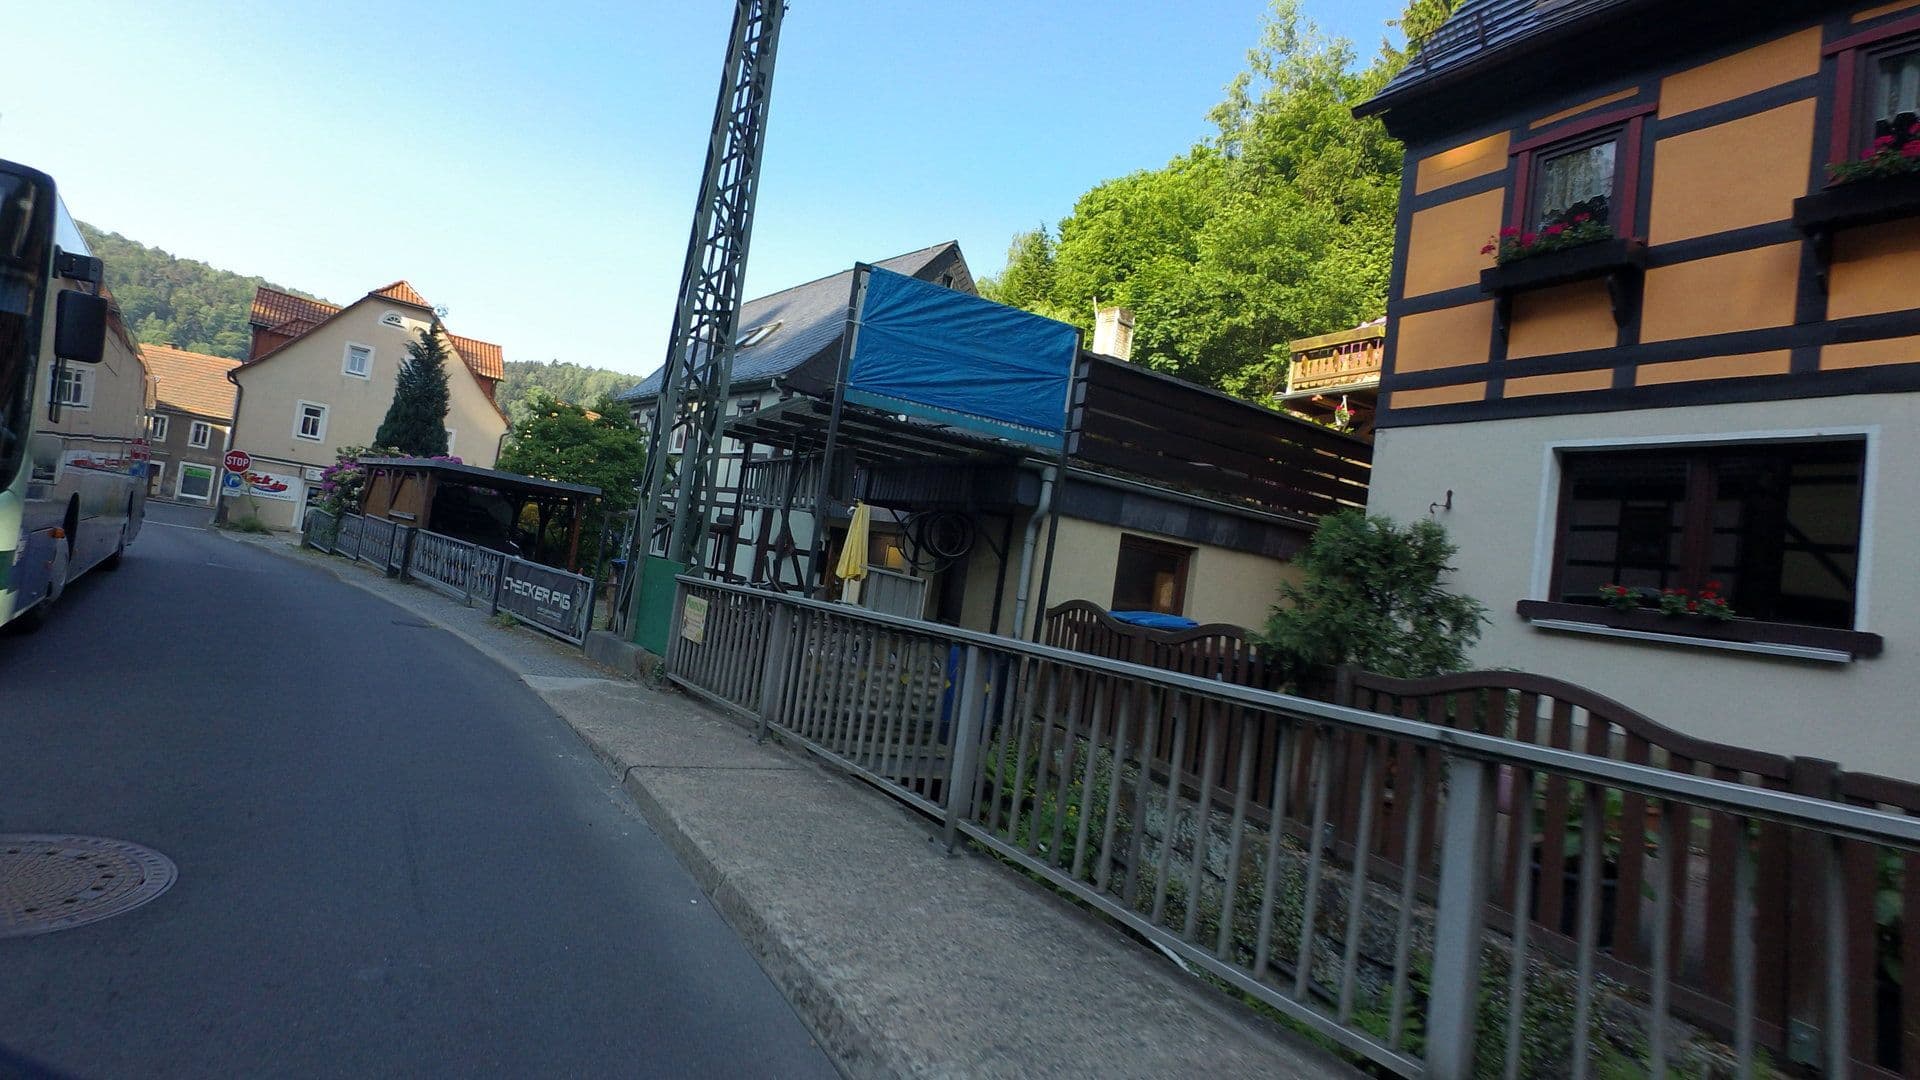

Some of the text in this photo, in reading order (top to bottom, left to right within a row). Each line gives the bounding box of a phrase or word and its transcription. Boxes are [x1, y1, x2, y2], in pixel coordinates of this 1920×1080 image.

[226, 455, 249, 467] STOP
[503, 576, 571, 611] CHECKER PIG
